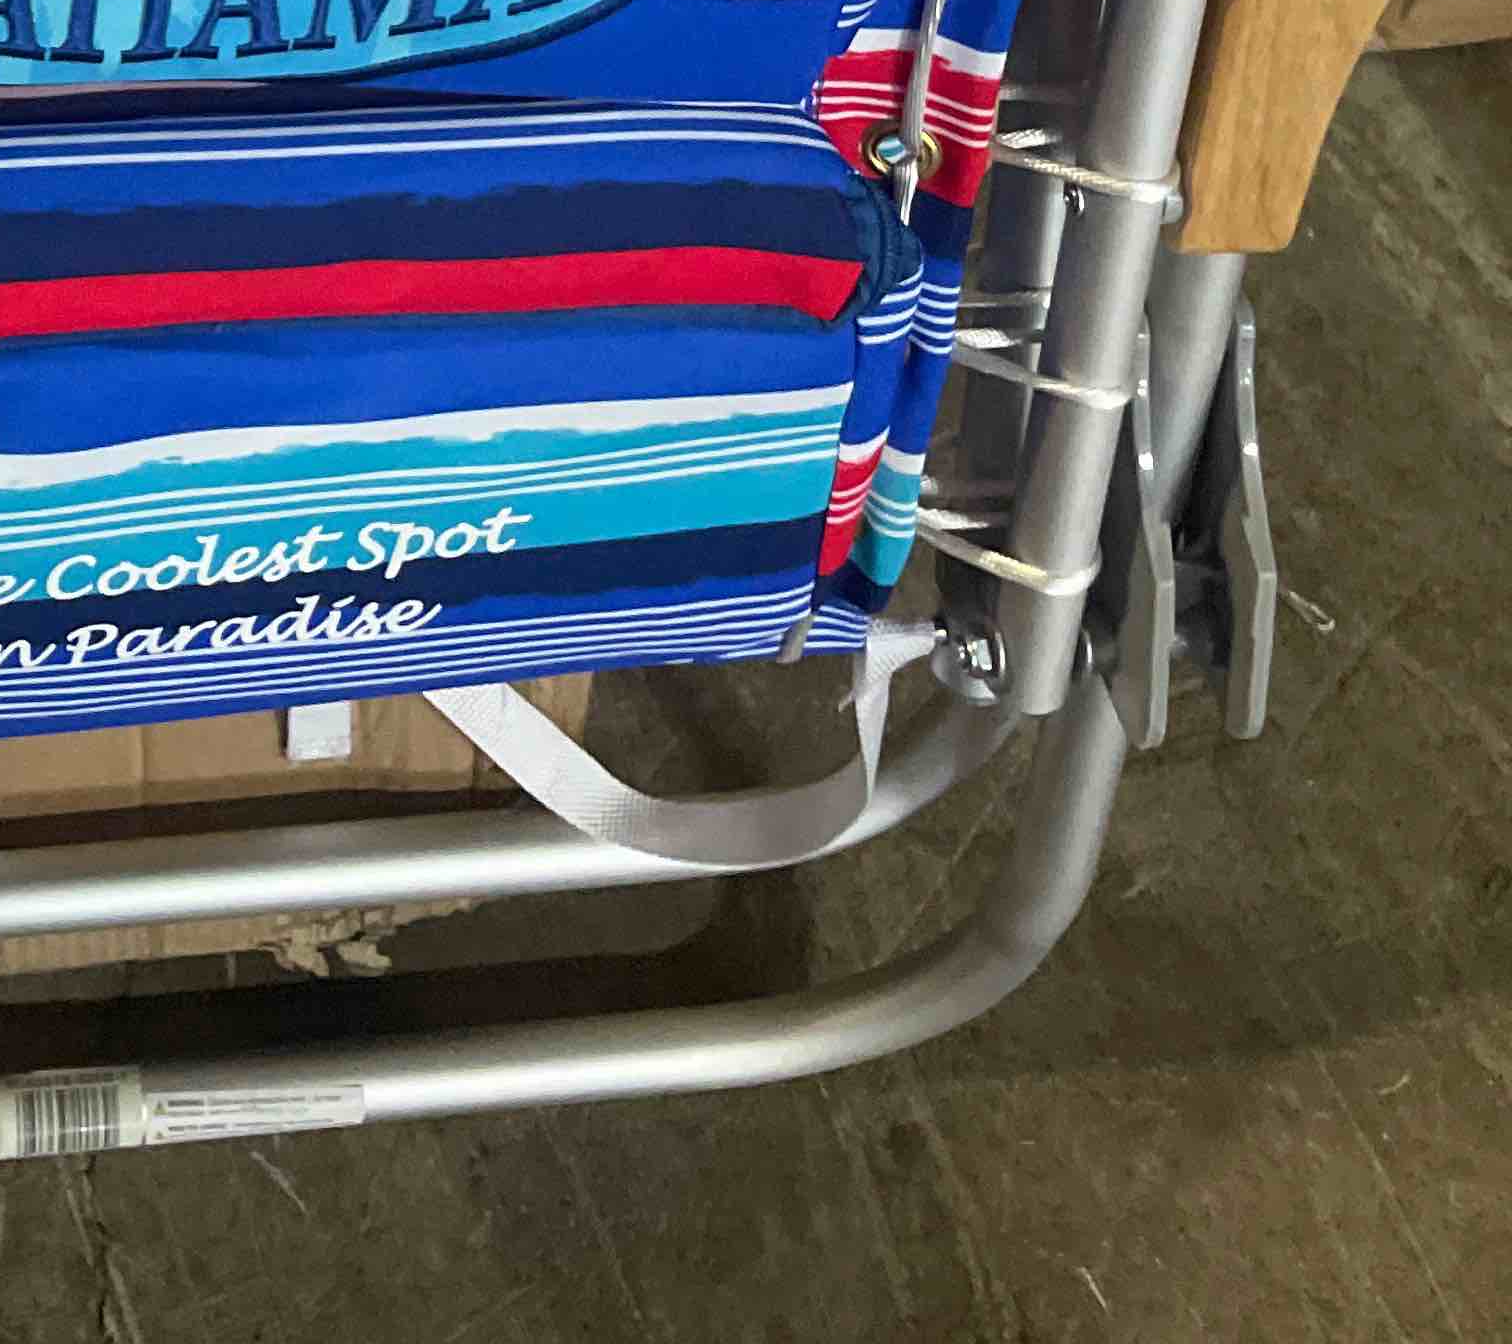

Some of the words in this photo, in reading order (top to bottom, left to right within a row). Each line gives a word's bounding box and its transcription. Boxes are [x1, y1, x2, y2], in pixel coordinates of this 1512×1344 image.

[44, 524, 344, 602] Coolest
[345, 506, 533, 579] Spot
[64, 592, 443, 666] Paradise
